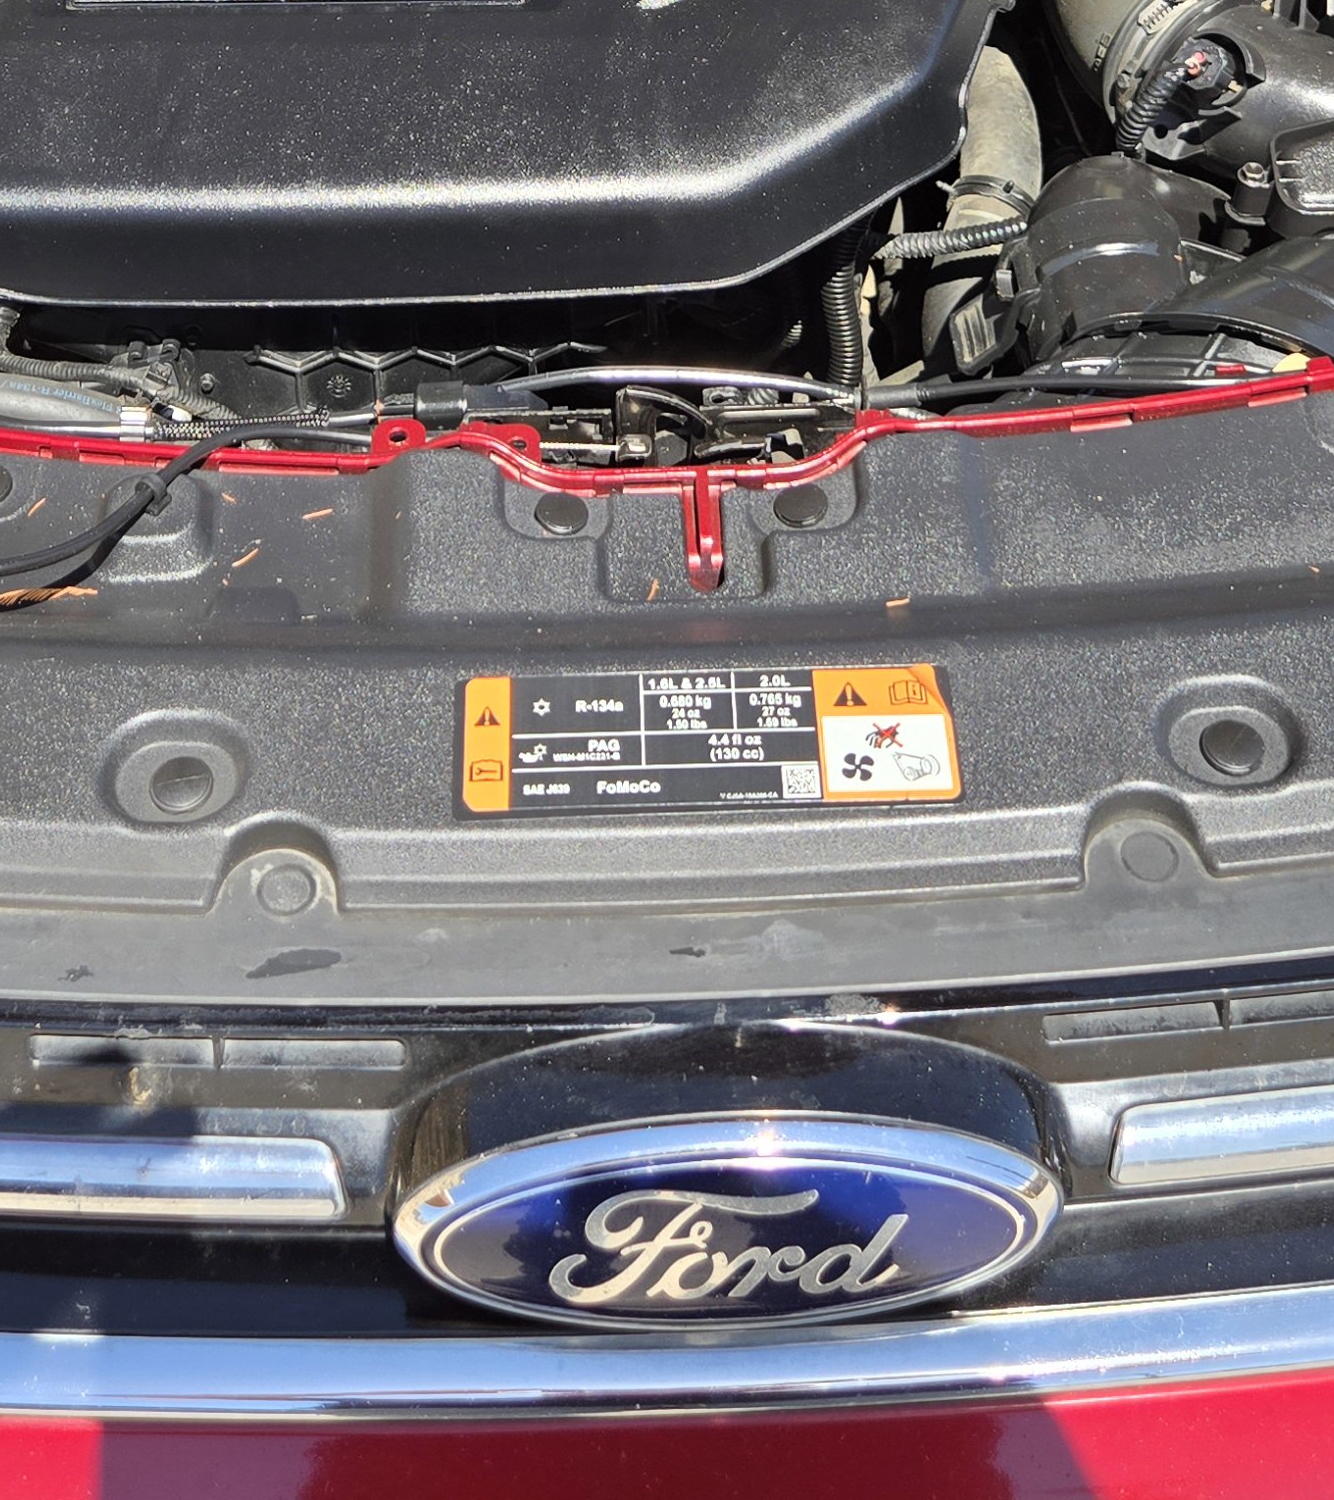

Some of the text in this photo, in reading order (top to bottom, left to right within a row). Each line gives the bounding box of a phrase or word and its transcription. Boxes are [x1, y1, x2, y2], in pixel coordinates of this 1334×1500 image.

[53, 388, 113, 412] FlexBarrier
[648, 678, 678, 690] 1.6L
[681, 677, 692, 689] &
[760, 674, 790, 687] 2.0L
[575, 699, 624, 712] R-134a
[695, 695, 712, 710] kg
[749, 692, 802, 707] 0.765 kg
[672, 708, 701, 719] 24 oz
[762, 706, 791, 717] 27 oz
[690, 719, 708, 729] lbs
[781, 717, 798, 727] lbs
[588, 739, 620, 752] PAG
[708, 734, 762, 745] 4.4 fl oz
[710, 747, 765, 762] (130 cc)
[523, 785, 545, 795] SAE
[597, 780, 661, 794] FoMoCo
[549, 1189, 909, 1304] Ford
